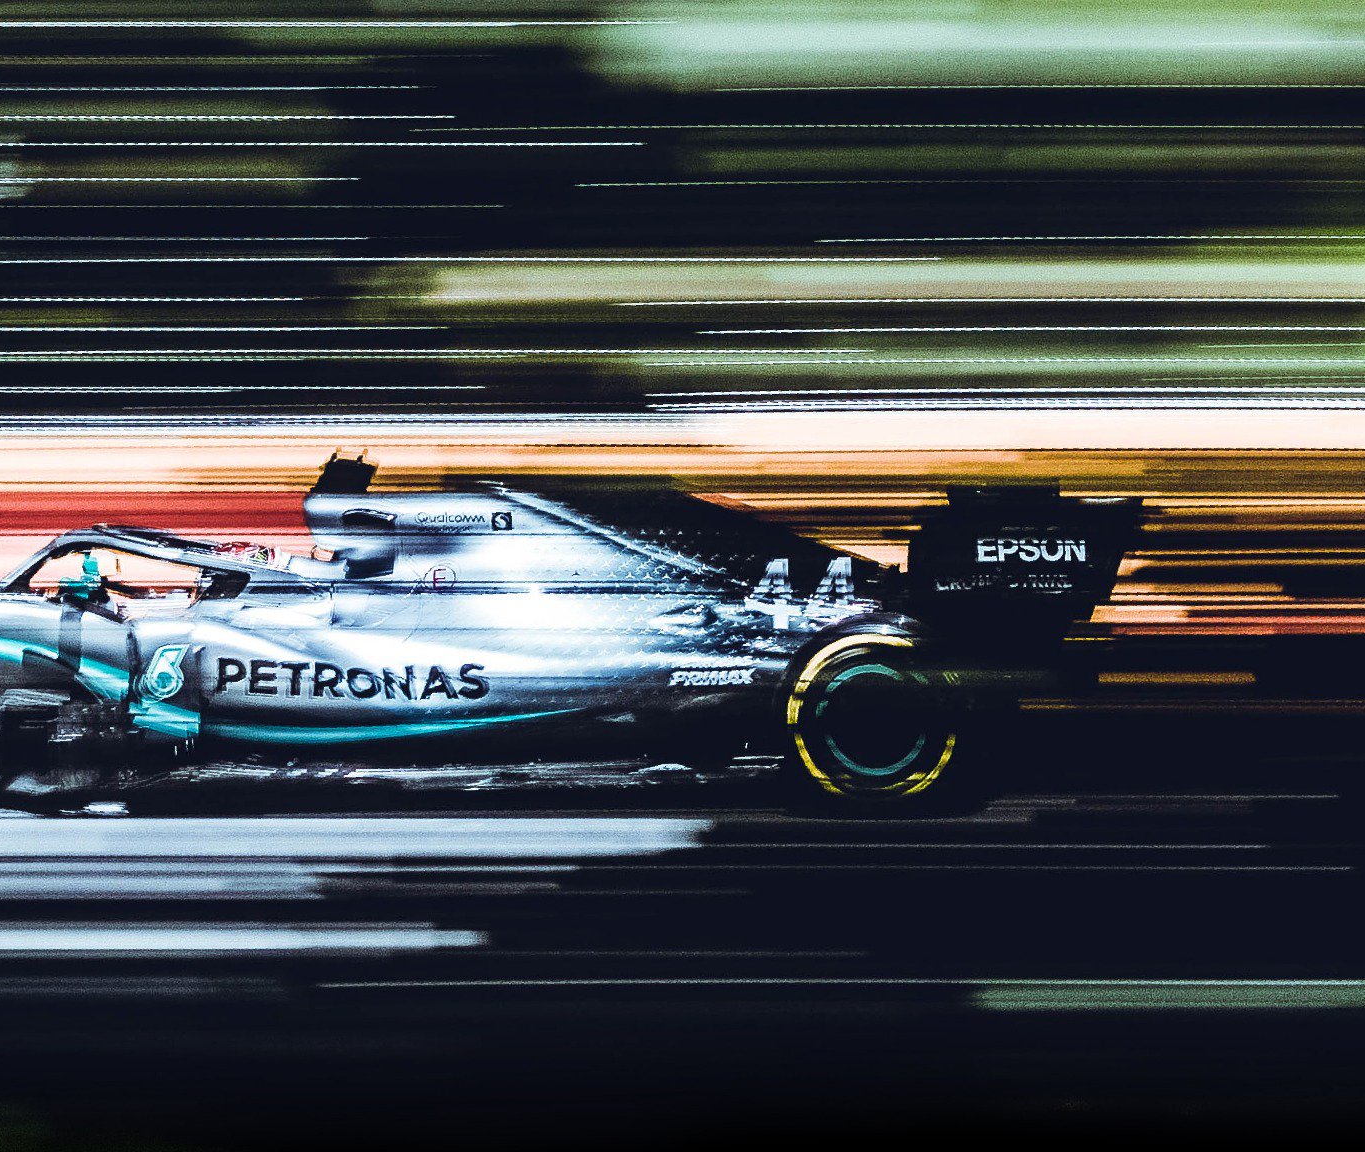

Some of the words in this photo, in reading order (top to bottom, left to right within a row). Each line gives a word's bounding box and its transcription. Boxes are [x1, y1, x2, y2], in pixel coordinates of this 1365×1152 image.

[416, 512, 486, 524] Qualcomm
[976, 538, 1086, 562] EPSON
[216, 657, 490, 700] PETRONAS
[669, 668, 756, 687] PRIMAX
